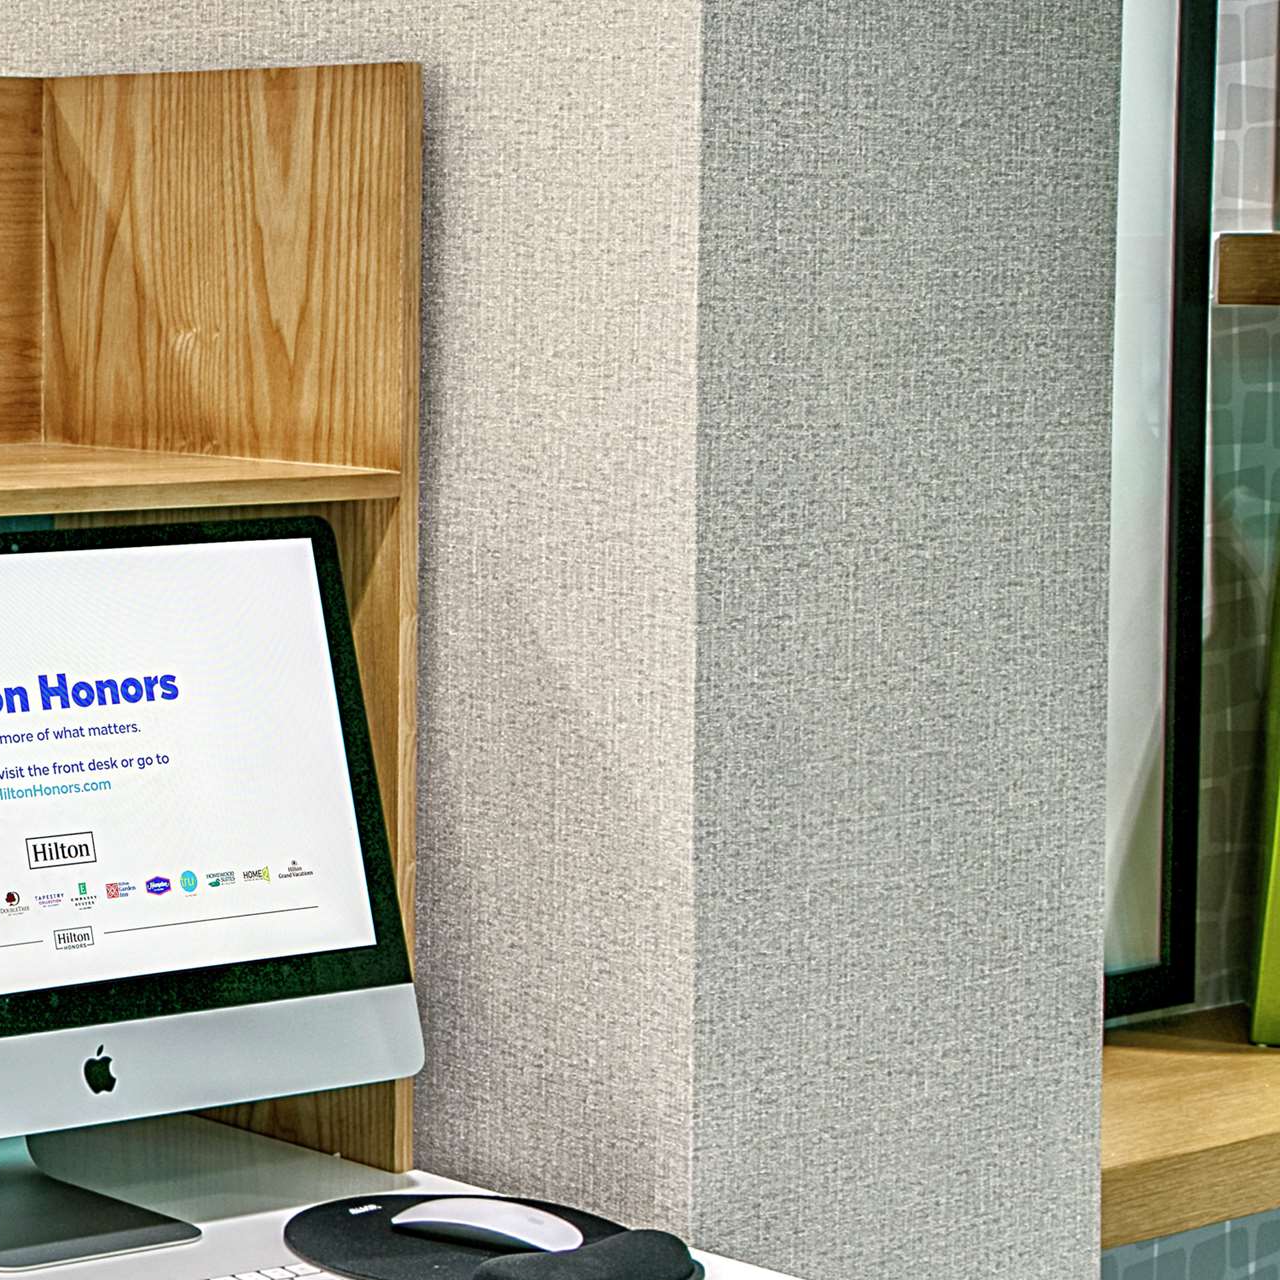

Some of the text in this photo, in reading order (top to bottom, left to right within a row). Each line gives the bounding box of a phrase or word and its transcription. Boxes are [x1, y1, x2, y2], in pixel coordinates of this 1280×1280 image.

[37, 673, 180, 711] Honors
[0, 730, 34, 745] more
[36, 727, 51, 741] of
[52, 725, 86, 740] what
[88, 722, 142, 737] matters.
[28, 763, 50, 777] the
[52, 760, 86, 776] front
[87, 757, 118, 772] desk
[120, 757, 135, 769] or
[137, 756, 154, 770] go
[155, 753, 170, 765] to
[31, 842, 91, 863] Hilton
[56, 932, 91, 945] Hilton
